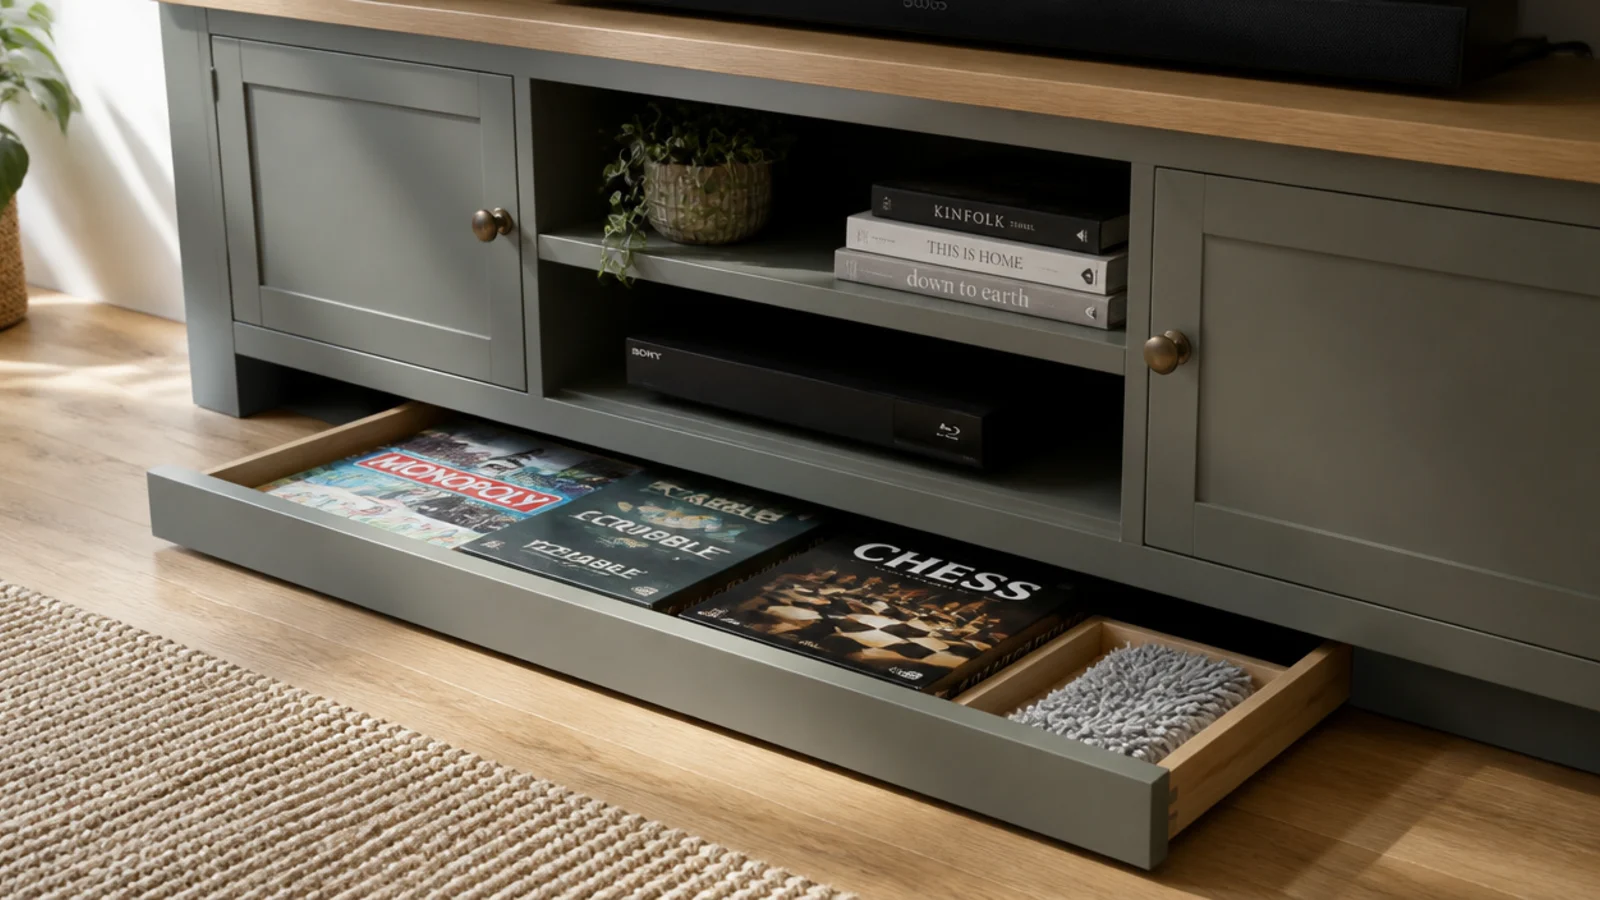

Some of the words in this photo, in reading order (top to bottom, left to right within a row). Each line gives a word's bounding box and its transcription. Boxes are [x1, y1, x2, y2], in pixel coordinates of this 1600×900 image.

[934, 204, 1005, 228] KINFOLK
[927, 239, 960, 258] THIS
[964, 246, 975, 261] IS
[978, 247, 1024, 270] HOME
[906, 267, 955, 294] down
[959, 280, 977, 297] to
[981, 287, 1030, 309] earth
[367, 453, 552, 509] MONOPOLY
[852, 541, 1043, 601] CHESS
